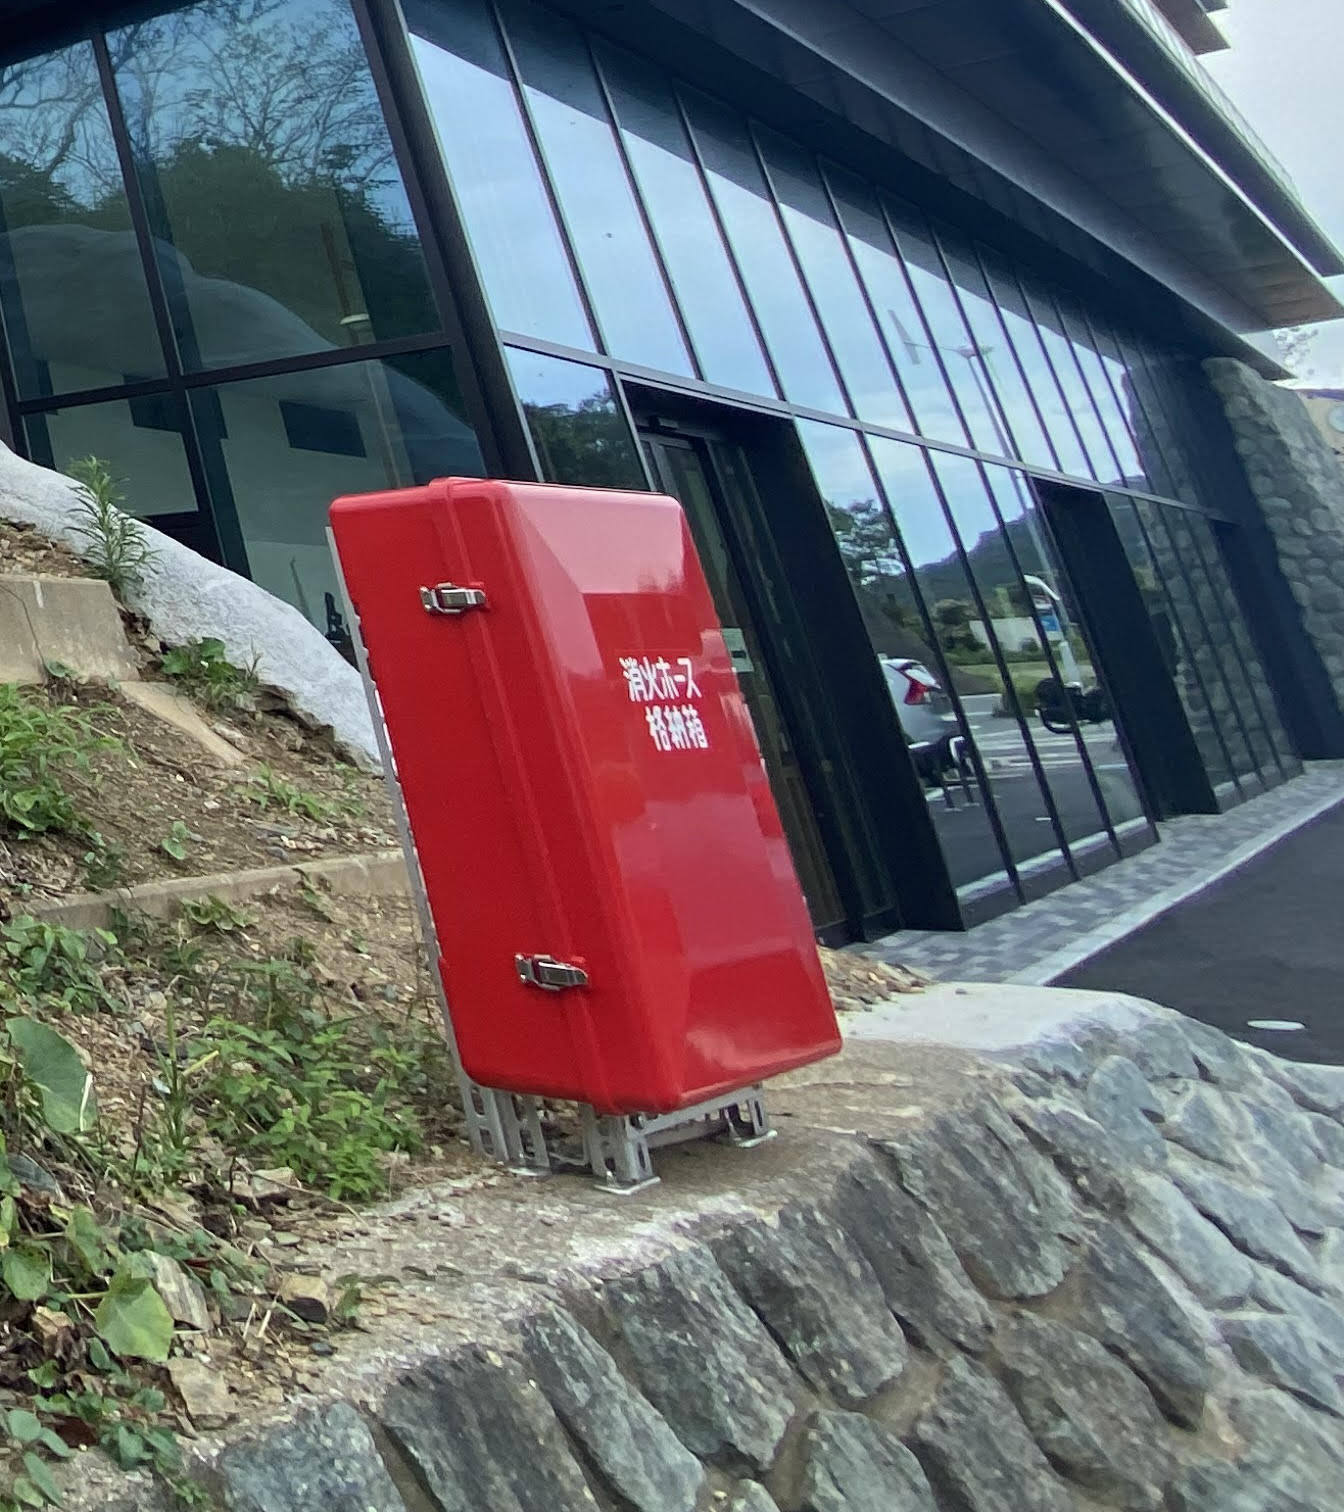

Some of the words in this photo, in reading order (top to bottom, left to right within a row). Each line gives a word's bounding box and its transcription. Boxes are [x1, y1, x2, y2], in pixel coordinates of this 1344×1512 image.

[618, 656, 703, 703] 消火ホース
[645, 703, 709, 751] 格納箱
